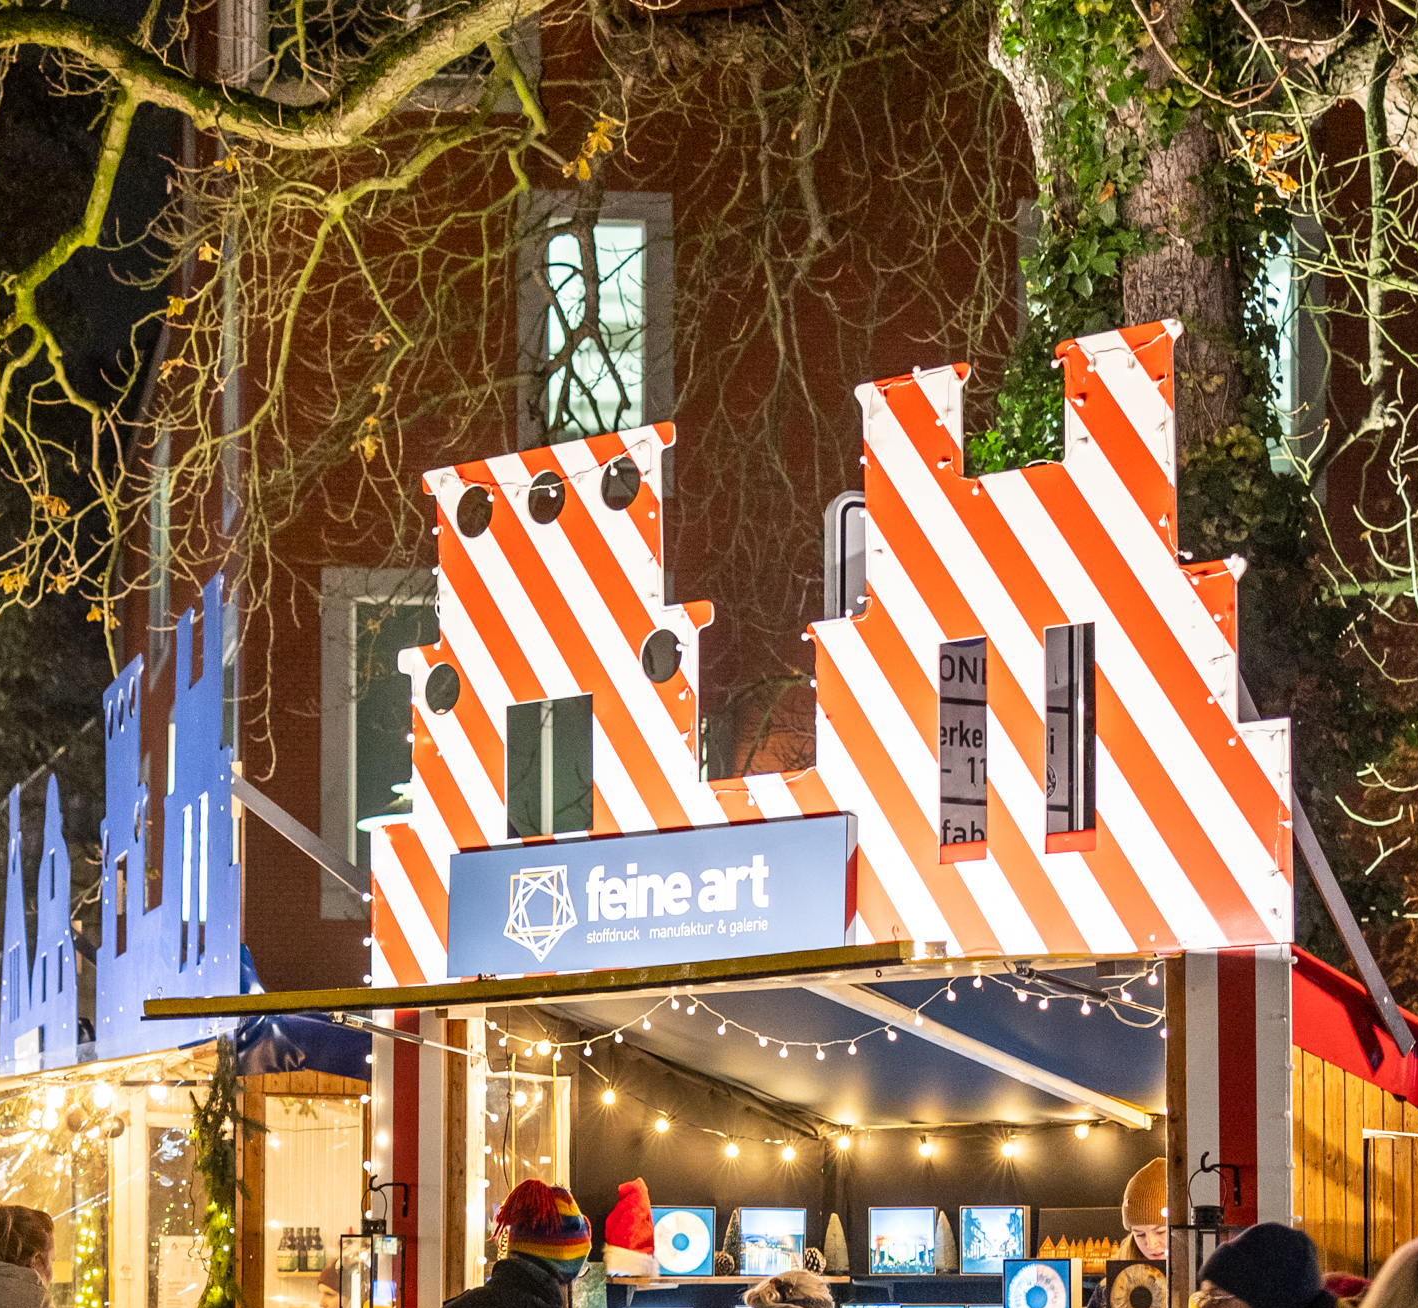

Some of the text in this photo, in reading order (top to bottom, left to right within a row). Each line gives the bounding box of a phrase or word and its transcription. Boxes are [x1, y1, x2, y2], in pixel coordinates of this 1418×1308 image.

[586, 854, 769, 922] feine art
[586, 916, 768, 944] stoffdruck manufaktur & galerie
